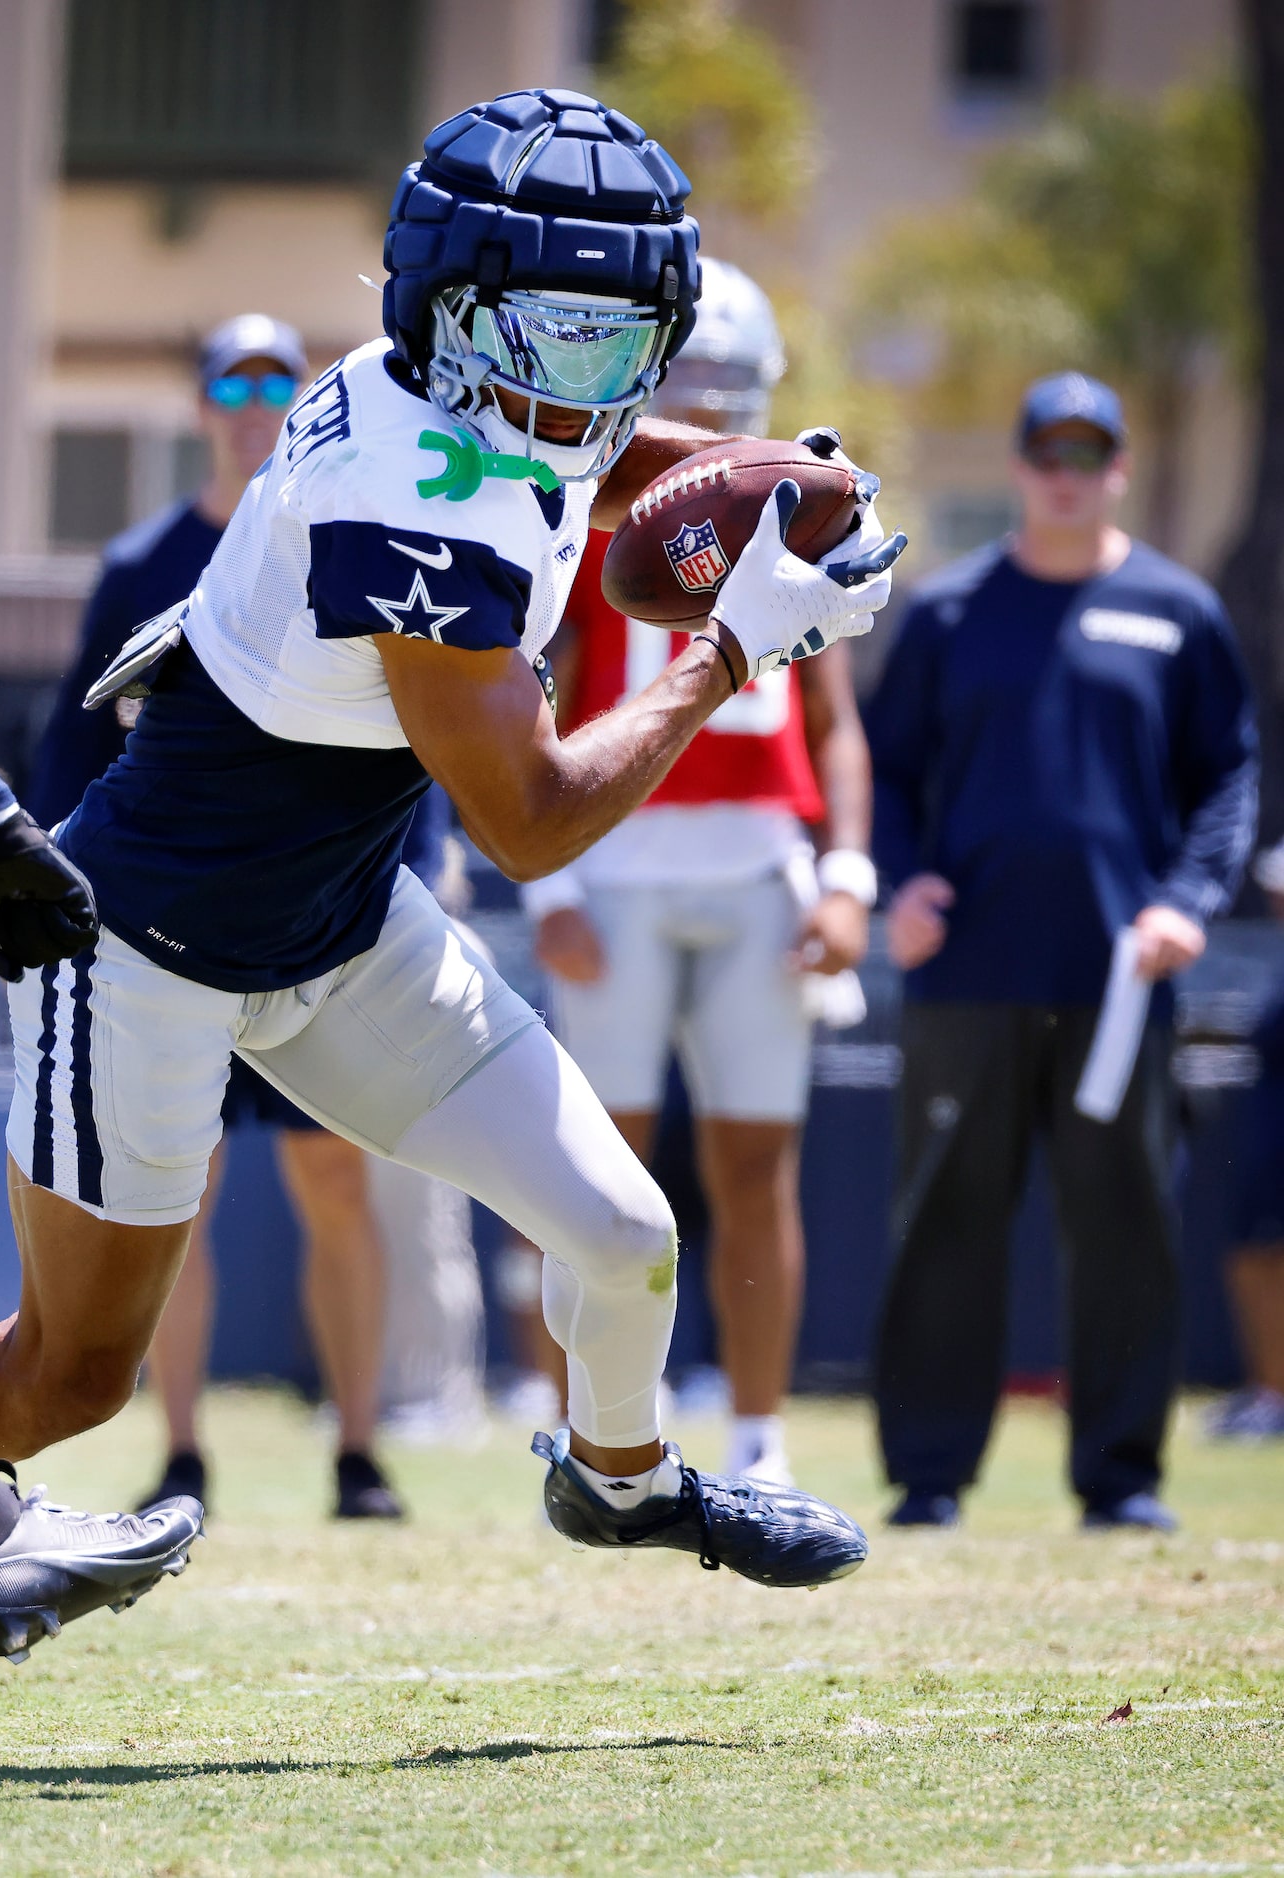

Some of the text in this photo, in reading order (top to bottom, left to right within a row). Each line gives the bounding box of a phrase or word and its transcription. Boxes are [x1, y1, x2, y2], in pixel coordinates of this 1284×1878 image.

[286, 356, 351, 476] ERT
[677, 549, 725, 587] NFL
[146, 926, 186, 952] DRI-FIT
